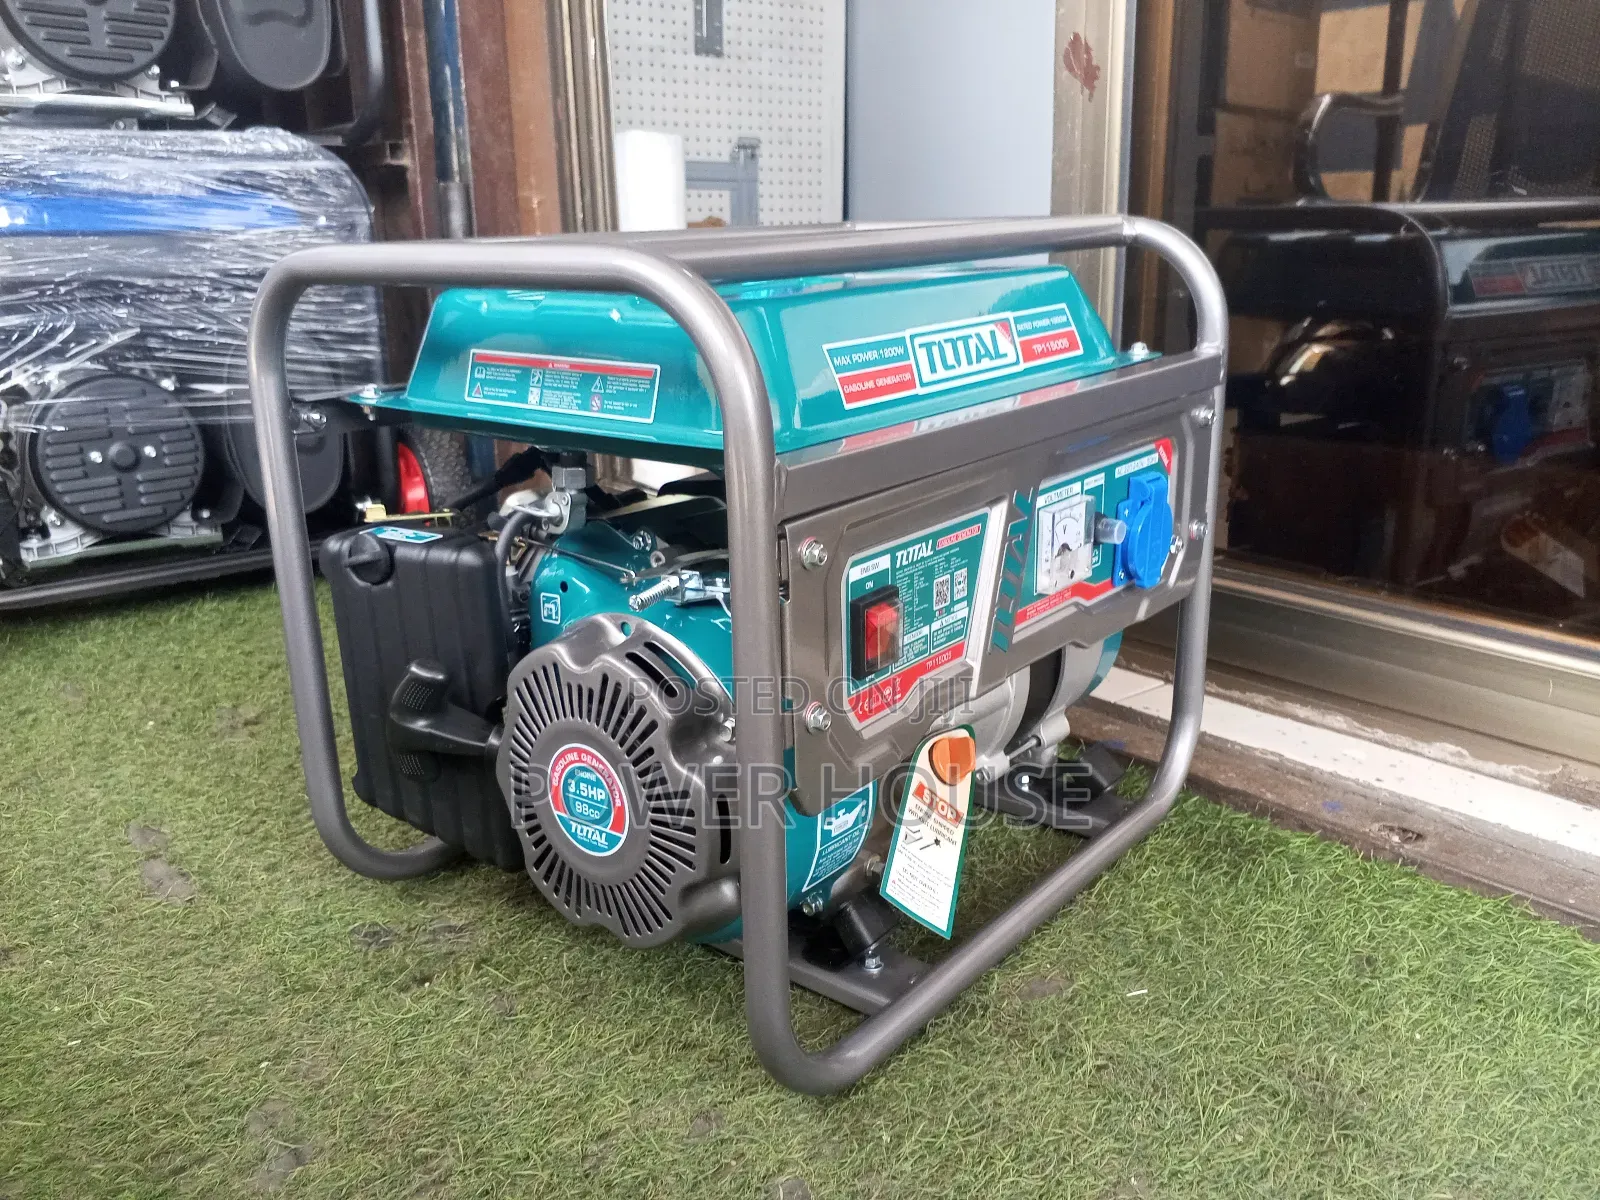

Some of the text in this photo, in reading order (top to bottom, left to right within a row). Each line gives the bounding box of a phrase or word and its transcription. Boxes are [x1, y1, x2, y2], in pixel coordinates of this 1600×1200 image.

[834, 354, 851, 367] MAX
[918, 330, 1008, 375] TOTAL
[843, 372, 912, 394] GASOLINE GENERATOR
[1044, 487, 1074, 504] VOLTMETER
[895, 538, 934, 569] TOTAL
[866, 580, 874, 590] ON
[553, 751, 622, 807] GASOLINE GENERATOR
[575, 768, 597, 782] ENGINE
[567, 778, 606, 801] 3.5HP
[922, 789, 958, 822] STOP
[570, 821, 609, 845] TOTAL
[822, 829, 861, 856] LUBRICANT OIL
[929, 823, 958, 847] LUBRICANT
